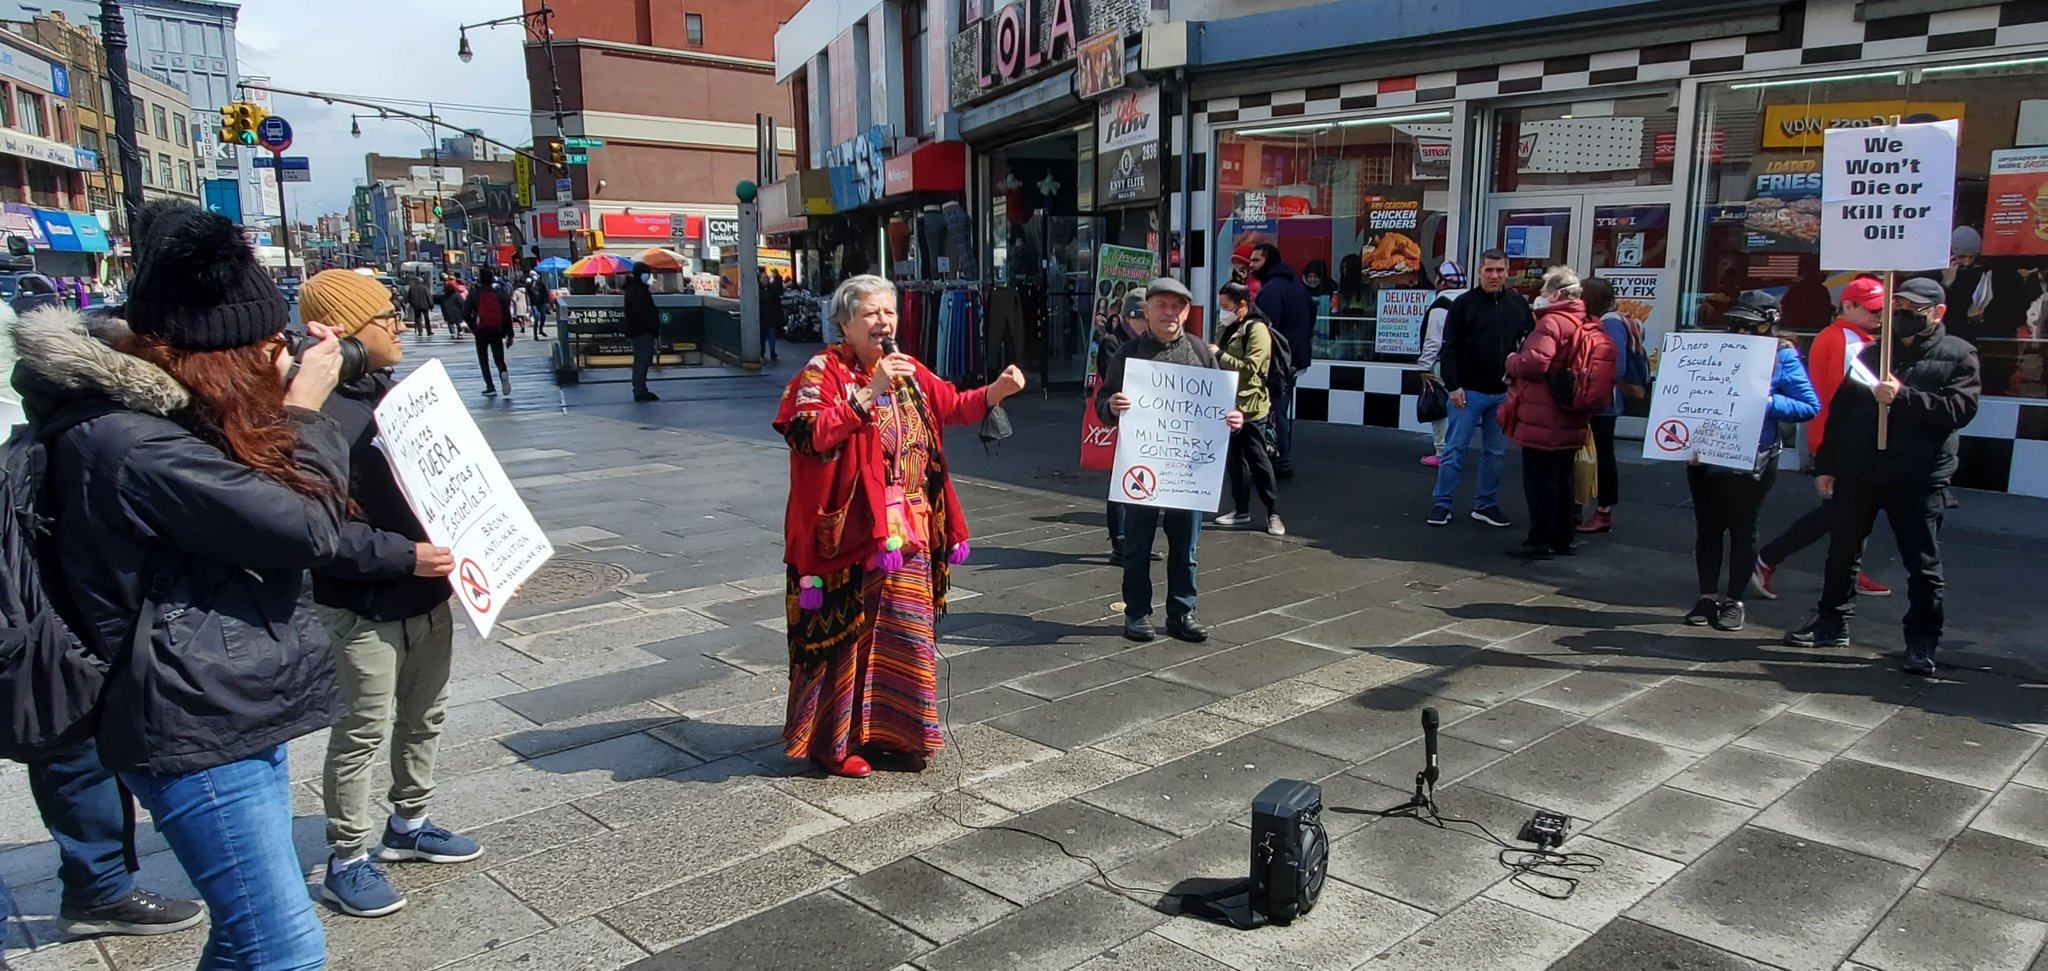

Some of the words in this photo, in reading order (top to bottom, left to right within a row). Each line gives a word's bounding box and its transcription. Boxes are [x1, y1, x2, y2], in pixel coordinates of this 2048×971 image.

[1864, 137, 1903, 153] We
[1765, 159, 1817, 173] LOADED
[1845, 158, 1921, 175] Won't
[1756, 172, 1823, 191] FRIES
[1850, 180, 1891, 196] Die
[1894, 182, 1923, 195] or
[1244, 192, 1267, 201] REAL
[1244, 207, 1267, 215] REAL
[1370, 210, 1418, 219] CHICKEN
[1842, 204, 1883, 220] Kill
[1892, 204, 1932, 219] for
[560, 219, 579, 227] TURNS
[1370, 219, 1417, 229] TENDERS
[671, 227, 684, 237] 25
[1863, 225, 1905, 240] Oil!
[1628, 277, 1657, 286] YOUR
[1385, 292, 1428, 303] DELIVERY
[1632, 286, 1656, 296] FIX
[598, 310, 608, 318] St
[1719, 342, 1748, 354] para
[1677, 355, 1722, 369] Escuelas
[1730, 363, 1741, 375] y
[1151, 371, 1213, 397] UNION
[1687, 369, 1732, 384] Trabajo,
[1662, 384, 1679, 395] NO
[1689, 388, 1715, 399] para
[1727, 386, 1741, 397] la
[1138, 395, 1227, 421] CONTRACTS
[1677, 401, 1723, 416] Guerra
[1157, 417, 1195, 432] NOT
[1702, 419, 1739, 432] BRONX
[1135, 428, 1214, 451] MILITARY
[1691, 435, 1742, 452] COALITION
[1139, 443, 1217, 463] CONTRACTS
[417, 434, 461, 488] FUERA
[1165, 461, 1193, 470] BRONX
[429, 465, 473, 512] Nuestras
[1159, 478, 1197, 486] COALITION
[481, 511, 510, 537] BRONX
[483, 524, 519, 559] ANTI-WAR
[491, 534, 530, 573] COALITION
